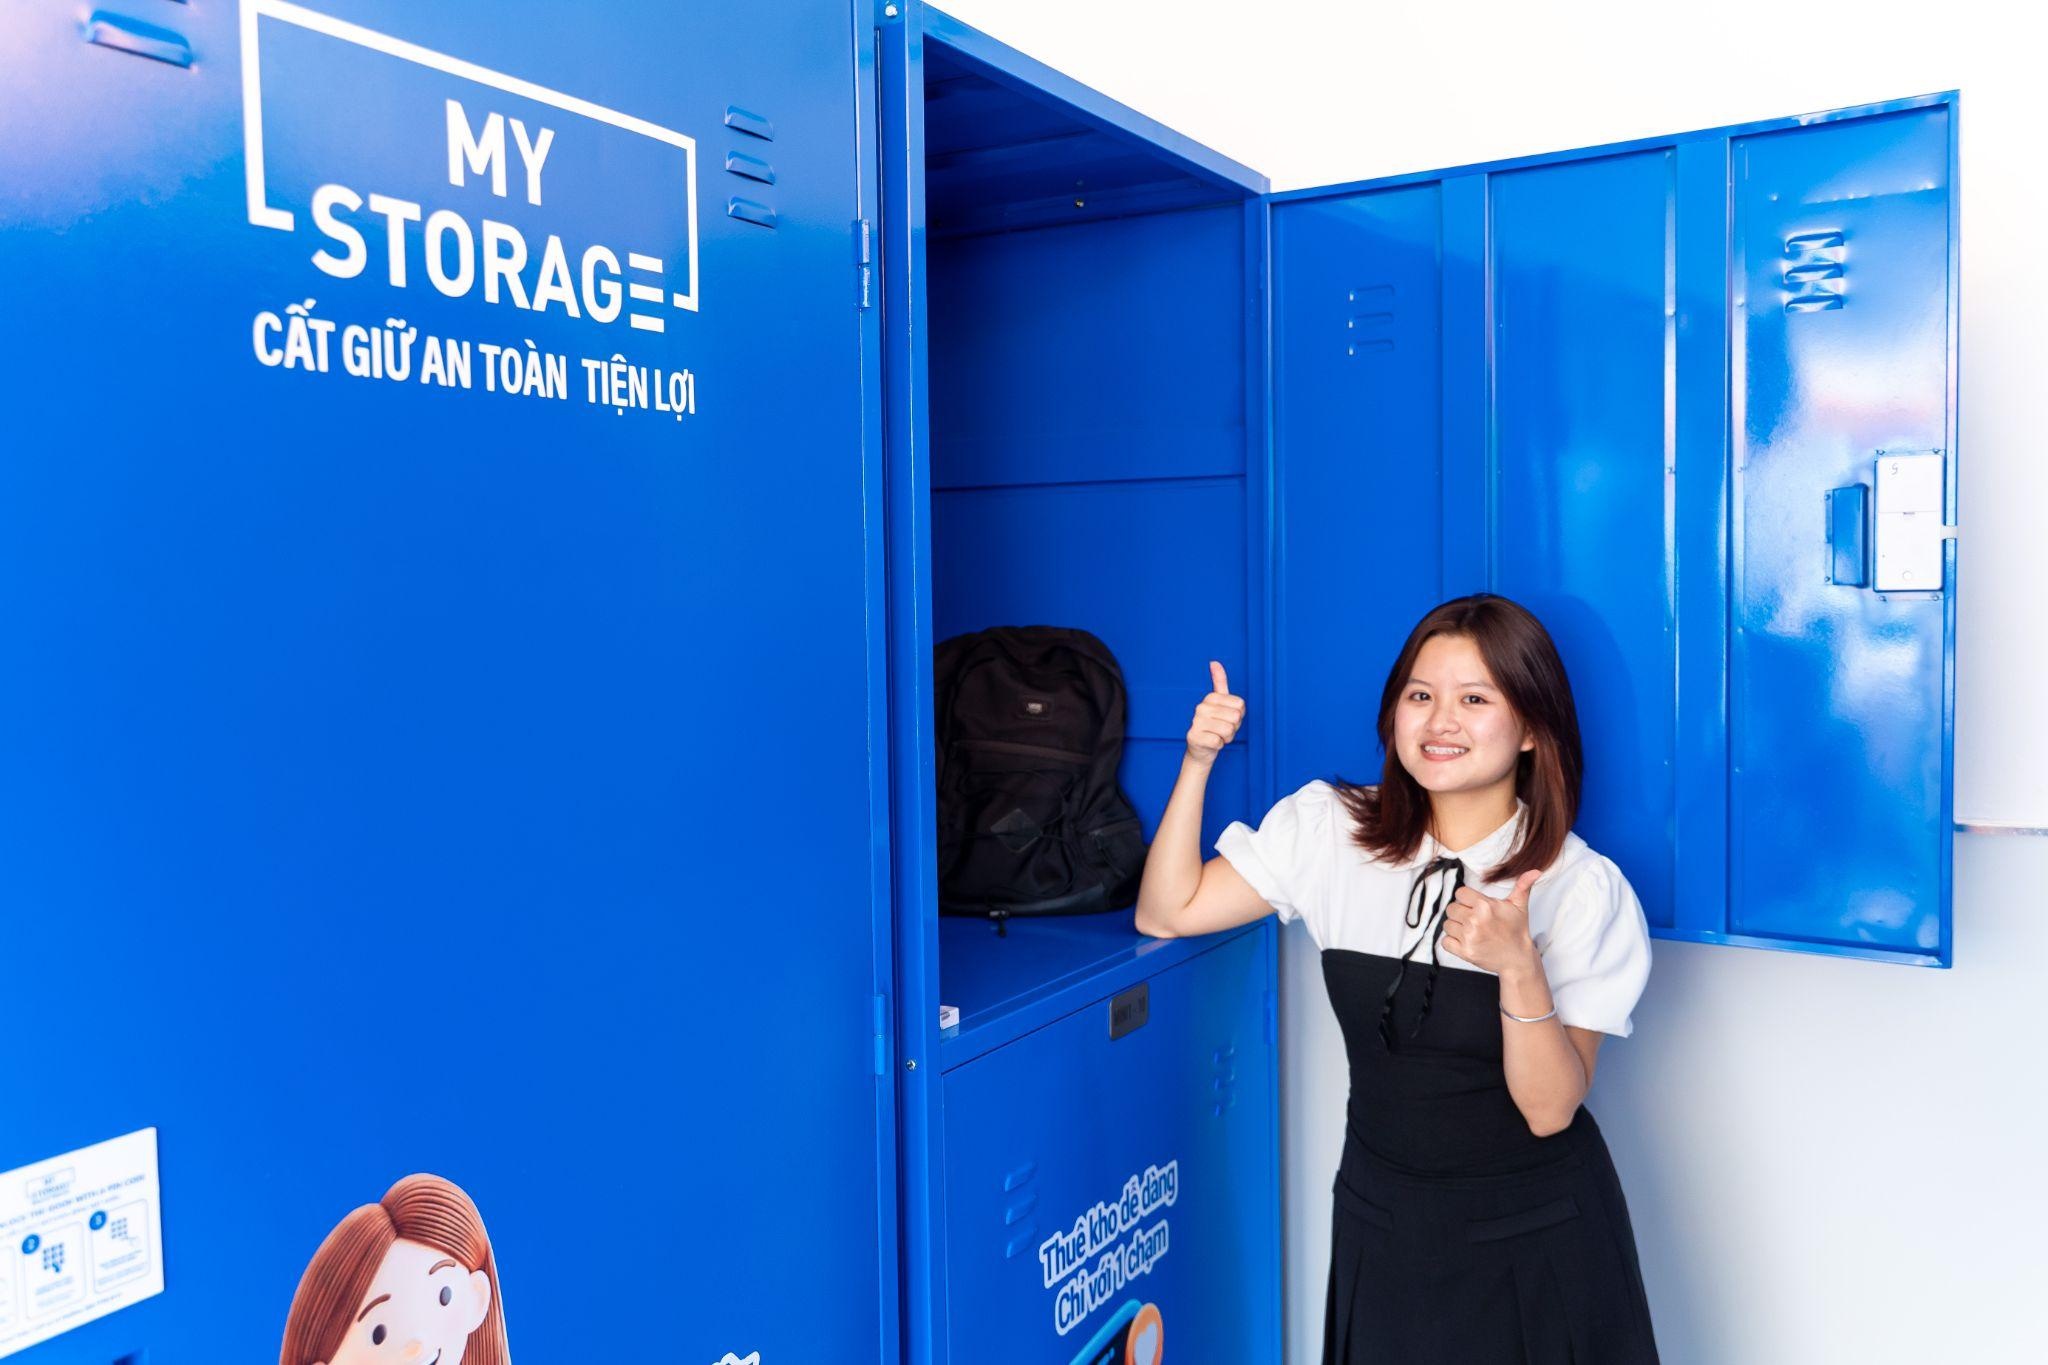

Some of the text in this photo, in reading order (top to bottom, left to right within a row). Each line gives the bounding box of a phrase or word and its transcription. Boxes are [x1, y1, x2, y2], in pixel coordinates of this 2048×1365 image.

[445, 98, 555, 207] MY
[310, 183, 665, 334] STORAGE
[252, 297, 696, 421] CẤT GIỮ AN TOÀN TIỆN LỢI
[1042, 1219, 1087, 1284] Thuê
[1088, 1206, 1118, 1249] kho
[1141, 1167, 1175, 1210] dàng
[1058, 1225, 1167, 1330] Chỉ với 1 chạm
